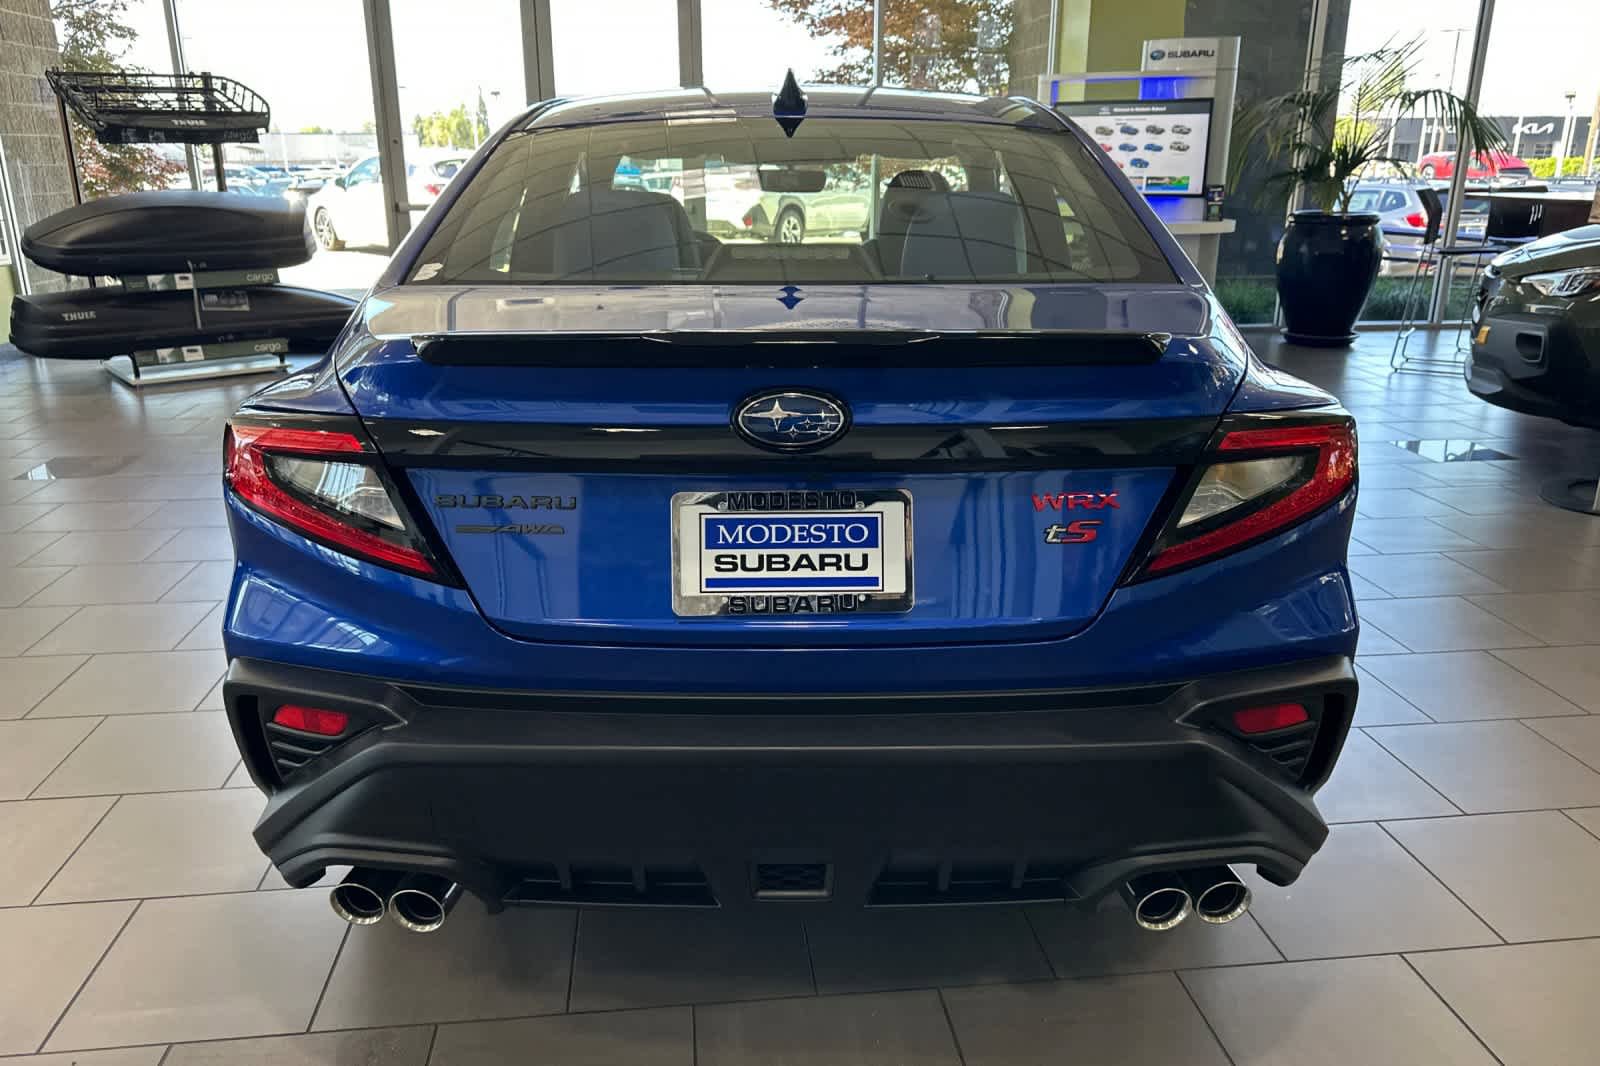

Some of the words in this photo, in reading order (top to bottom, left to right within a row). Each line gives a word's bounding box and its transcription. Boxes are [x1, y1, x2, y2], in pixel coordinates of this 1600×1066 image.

[1168, 49, 1215, 59] SUBARU
[171, 119, 207, 127] THULE
[246, 273, 274, 284] cargo
[61, 310, 97, 321] THULE
[254, 342, 282, 353] cargo
[435, 493, 577, 510] SUBARU
[726, 491, 857, 511] MODESTO
[1031, 490, 1121, 512] WRX
[717, 523, 869, 544] MODESTO
[1044, 519, 1104, 544] tS
[713, 553, 870, 573] SUBARU
[727, 594, 860, 615] SUBARU
